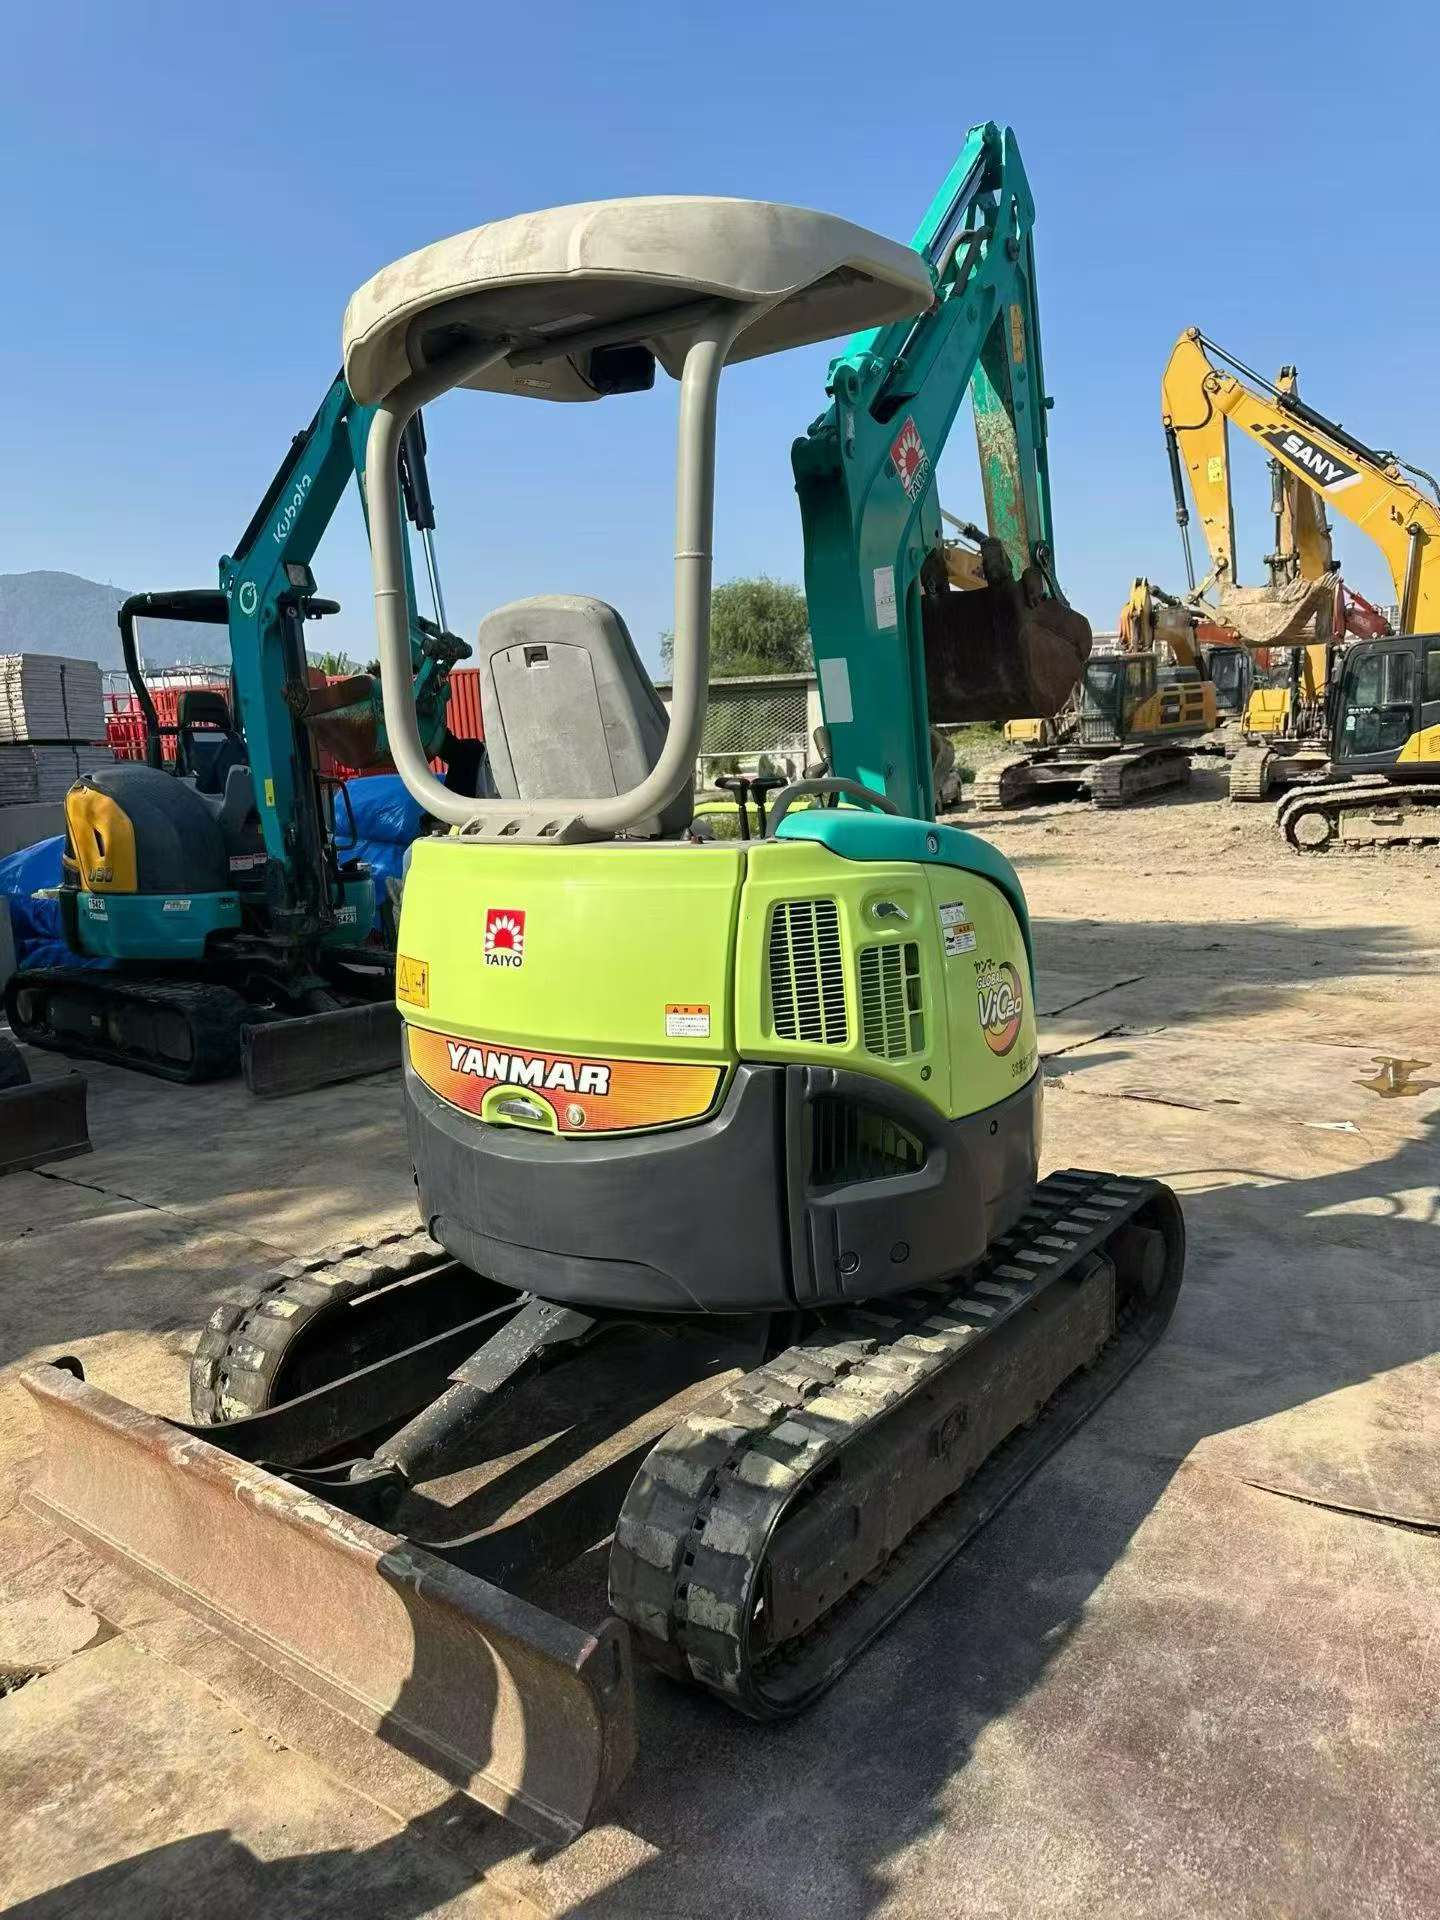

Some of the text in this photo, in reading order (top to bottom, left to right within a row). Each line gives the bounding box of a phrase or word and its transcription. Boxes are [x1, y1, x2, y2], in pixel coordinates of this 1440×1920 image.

[1281, 434, 1345, 482] SANY
[273, 474, 312, 544] Kubota
[485, 953, 523, 967] TAIYO
[974, 958, 996, 974] ヤンマー
[976, 972, 1004, 991] GLOBAL
[447, 1040, 611, 1096] YANMAR
